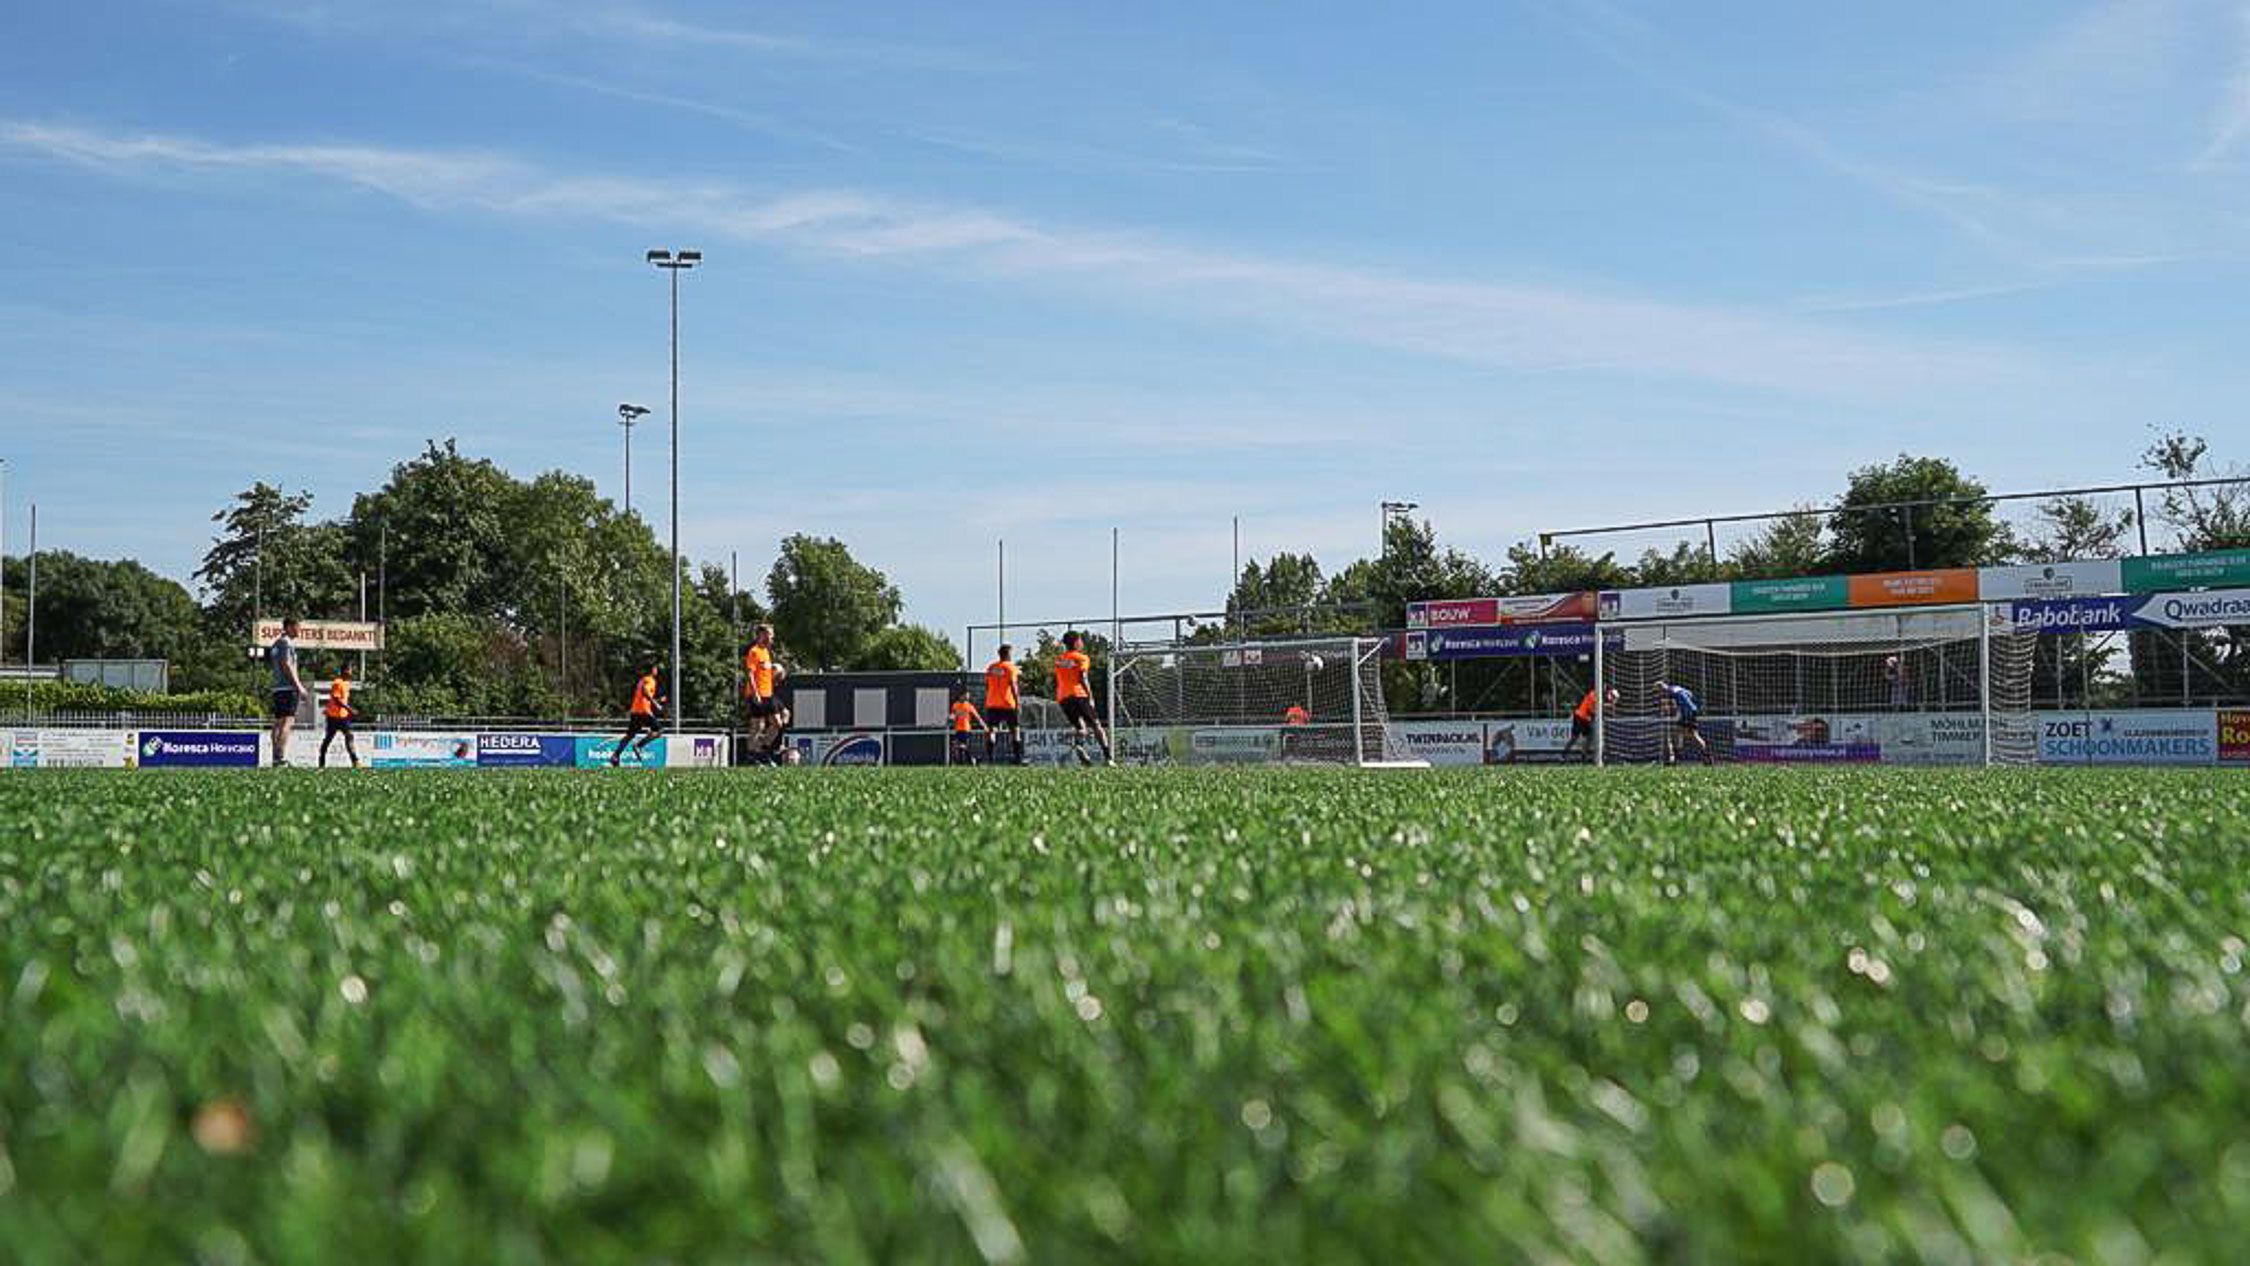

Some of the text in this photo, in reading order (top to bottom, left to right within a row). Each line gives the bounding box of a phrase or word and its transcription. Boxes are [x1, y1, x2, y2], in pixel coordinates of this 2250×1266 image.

[2018, 602, 2121, 627] Rabobank
[2045, 722, 2090, 737] ZOET
[480, 737, 541, 748] HEDERA
[2045, 738, 2211, 756] SCHOONMAKERS
